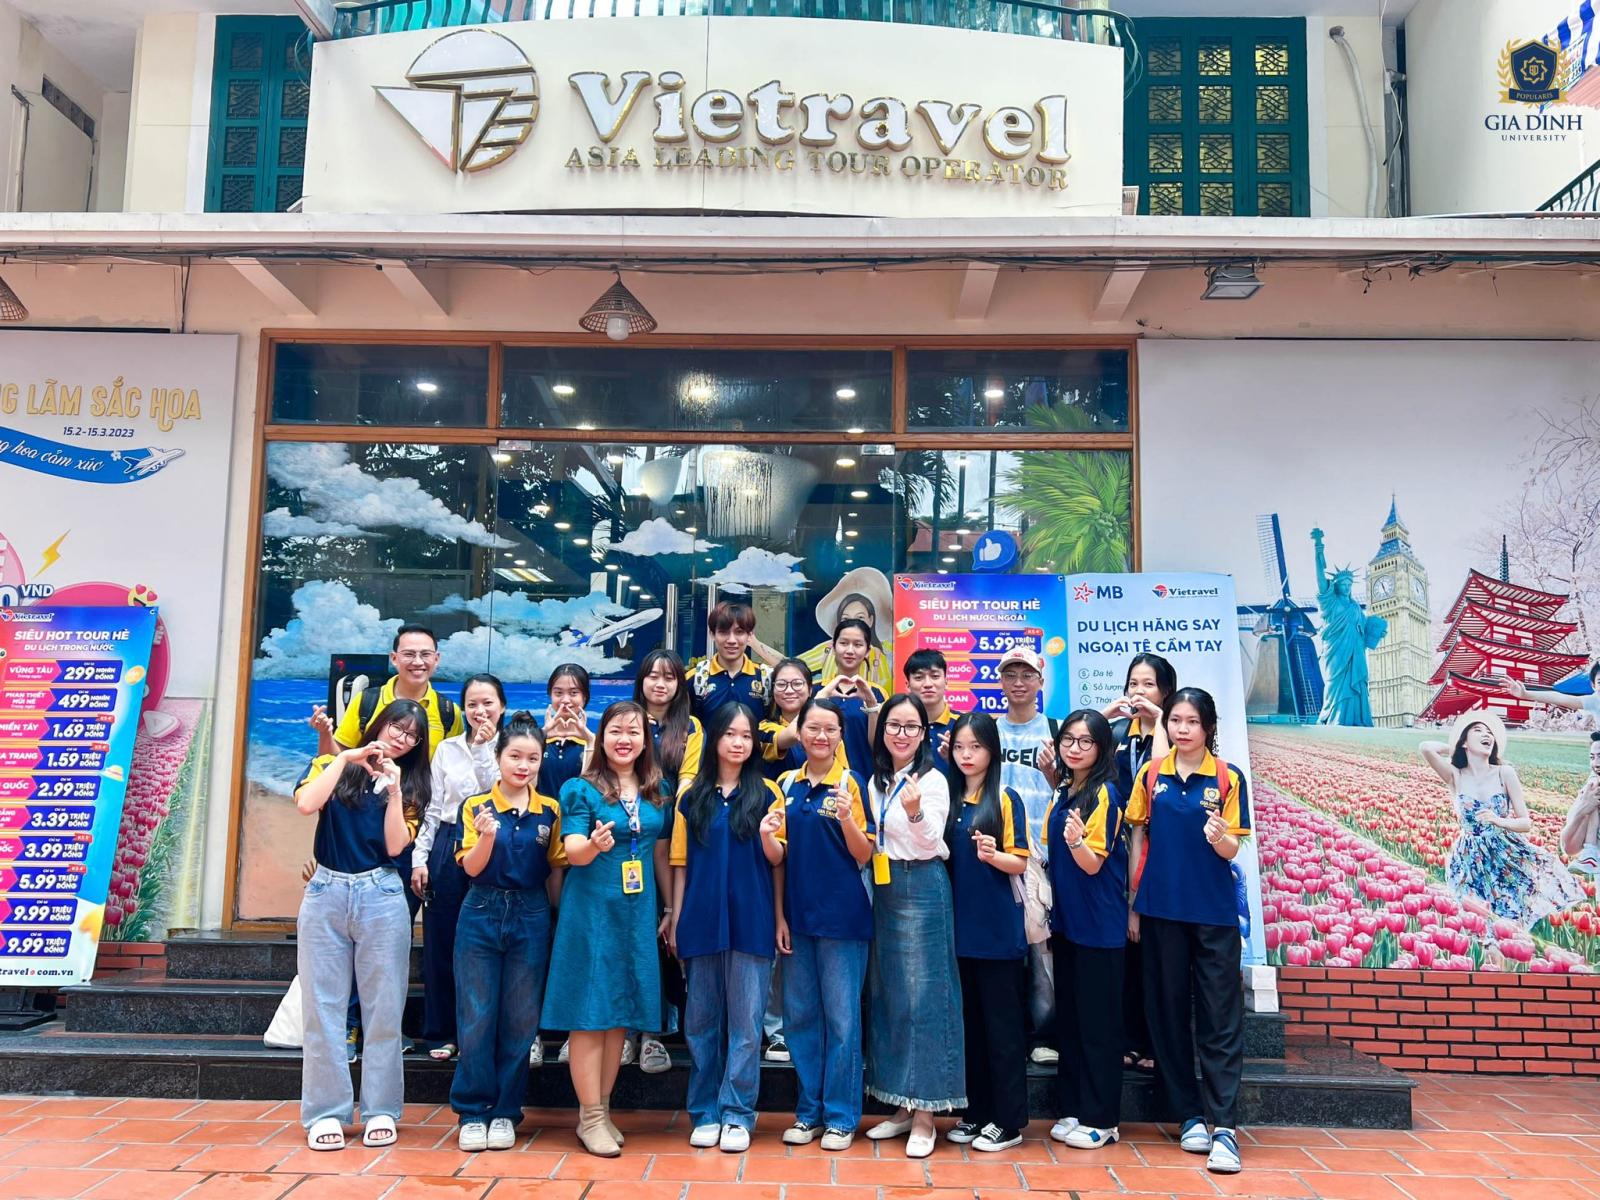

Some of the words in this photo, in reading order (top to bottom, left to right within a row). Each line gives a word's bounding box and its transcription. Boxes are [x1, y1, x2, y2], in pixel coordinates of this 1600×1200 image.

[568, 70, 1071, 163] Vietravel
[564, 145, 641, 169] ASIA
[652, 146, 796, 170] LEADING
[806, 150, 891, 177] TOUR
[900, 155, 1069, 192] OPERATOR
[26, 379, 82, 416] LÃM
[150, 387, 201, 432] HOA
[63, 426, 135, 438] 15.2-15.3.2023
[11, 439, 39, 459] hoa
[20, 584, 54, 597] VND
[912, 581, 956, 589] Vietravel
[1096, 585, 1124, 599] MB
[1168, 587, 1219, 596] Vietravel
[919, 597, 950, 611] SIÊU
[952, 599, 980, 611] HOT
[983, 599, 1020, 611] TOUR
[1022, 597, 1041, 611] HÈ
[933, 613, 947, 621] DU
[1078, 621, 1099, 632] DU
[1103, 620, 1139, 635] LỊCH
[1193, 618, 1221, 631] SAY
[14, 629, 44, 641] SIÊU
[46, 631, 73, 641] HOT
[75, 631, 110, 641] TOUR
[948, 636, 967, 644] LAN
[24, 643, 37, 651] DU
[60, 643, 89, 651] TRONG
[979, 636, 1015, 651] 5.99
[1078, 640, 1129, 656] NGOẠI
[1195, 639, 1223, 652] TAY
[64, 666, 94, 680] 299
[58, 693, 90, 708] 499
[53, 723, 85, 738] 1.69
[9, 752, 38, 760] TRANG
[47, 752, 80, 767] 1.59
[37, 782, 75, 797] 2.99
[31, 812, 69, 828] 3.39
[24, 842, 63, 858] 3.99
[18, 873, 57, 889] 5.99
[13, 905, 51, 921] 9.99
[7, 937, 44, 953] 9.99
